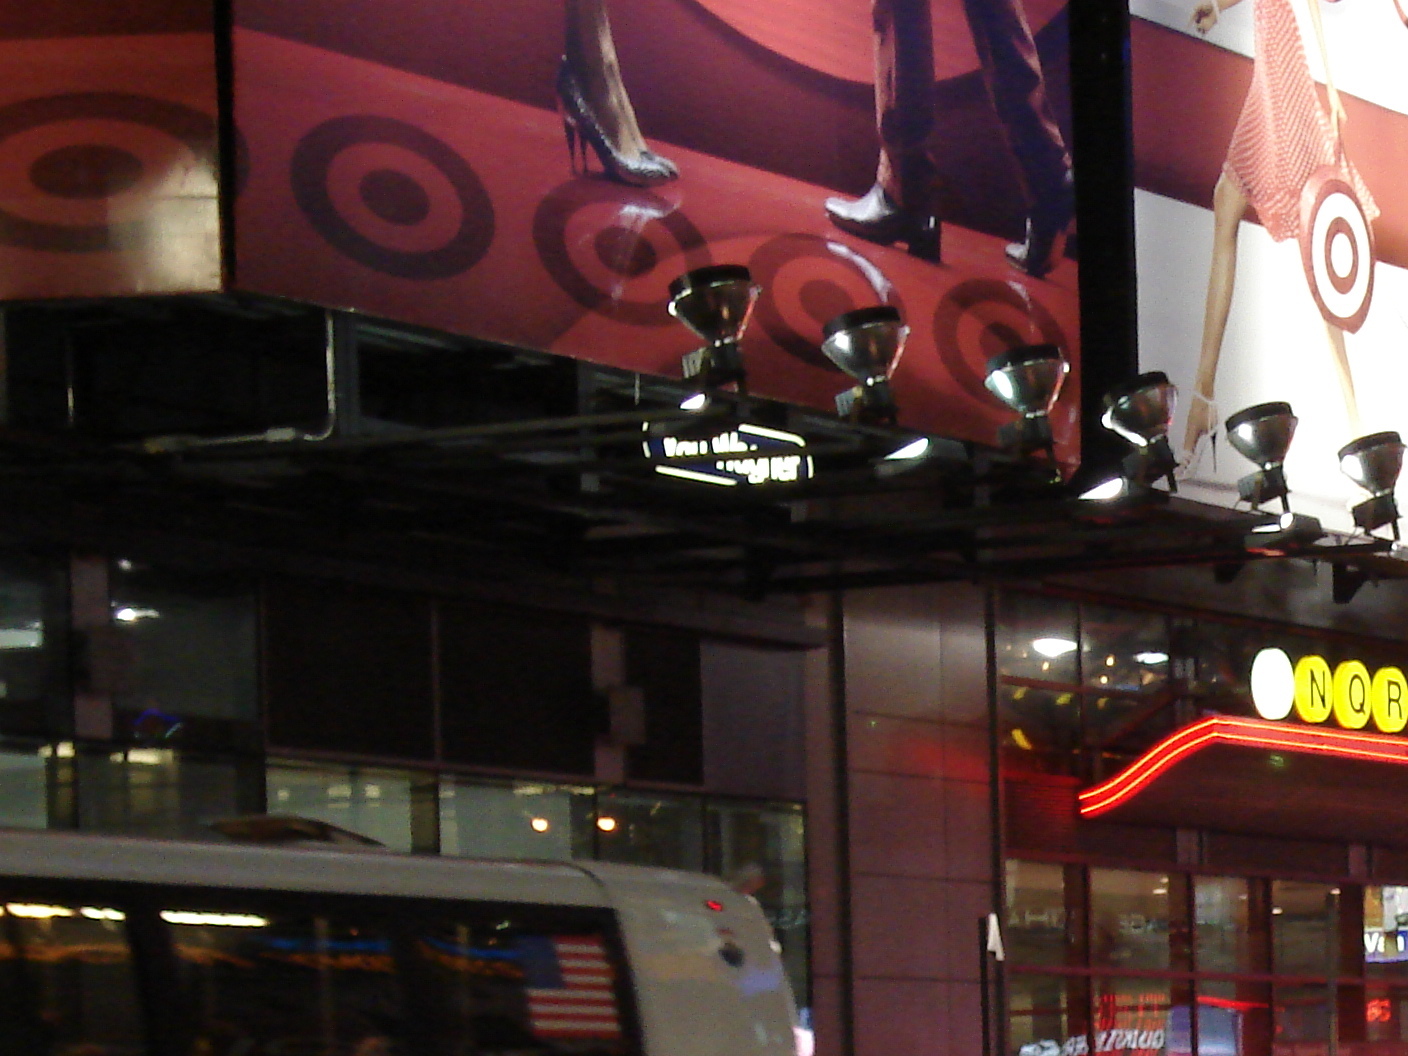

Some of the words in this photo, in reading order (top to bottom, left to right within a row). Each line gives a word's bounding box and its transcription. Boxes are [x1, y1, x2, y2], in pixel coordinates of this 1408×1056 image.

[1309, 668, 1327, 710] N
[1349, 674, 1367, 716] Q
[1387, 680, 1403, 720] R
